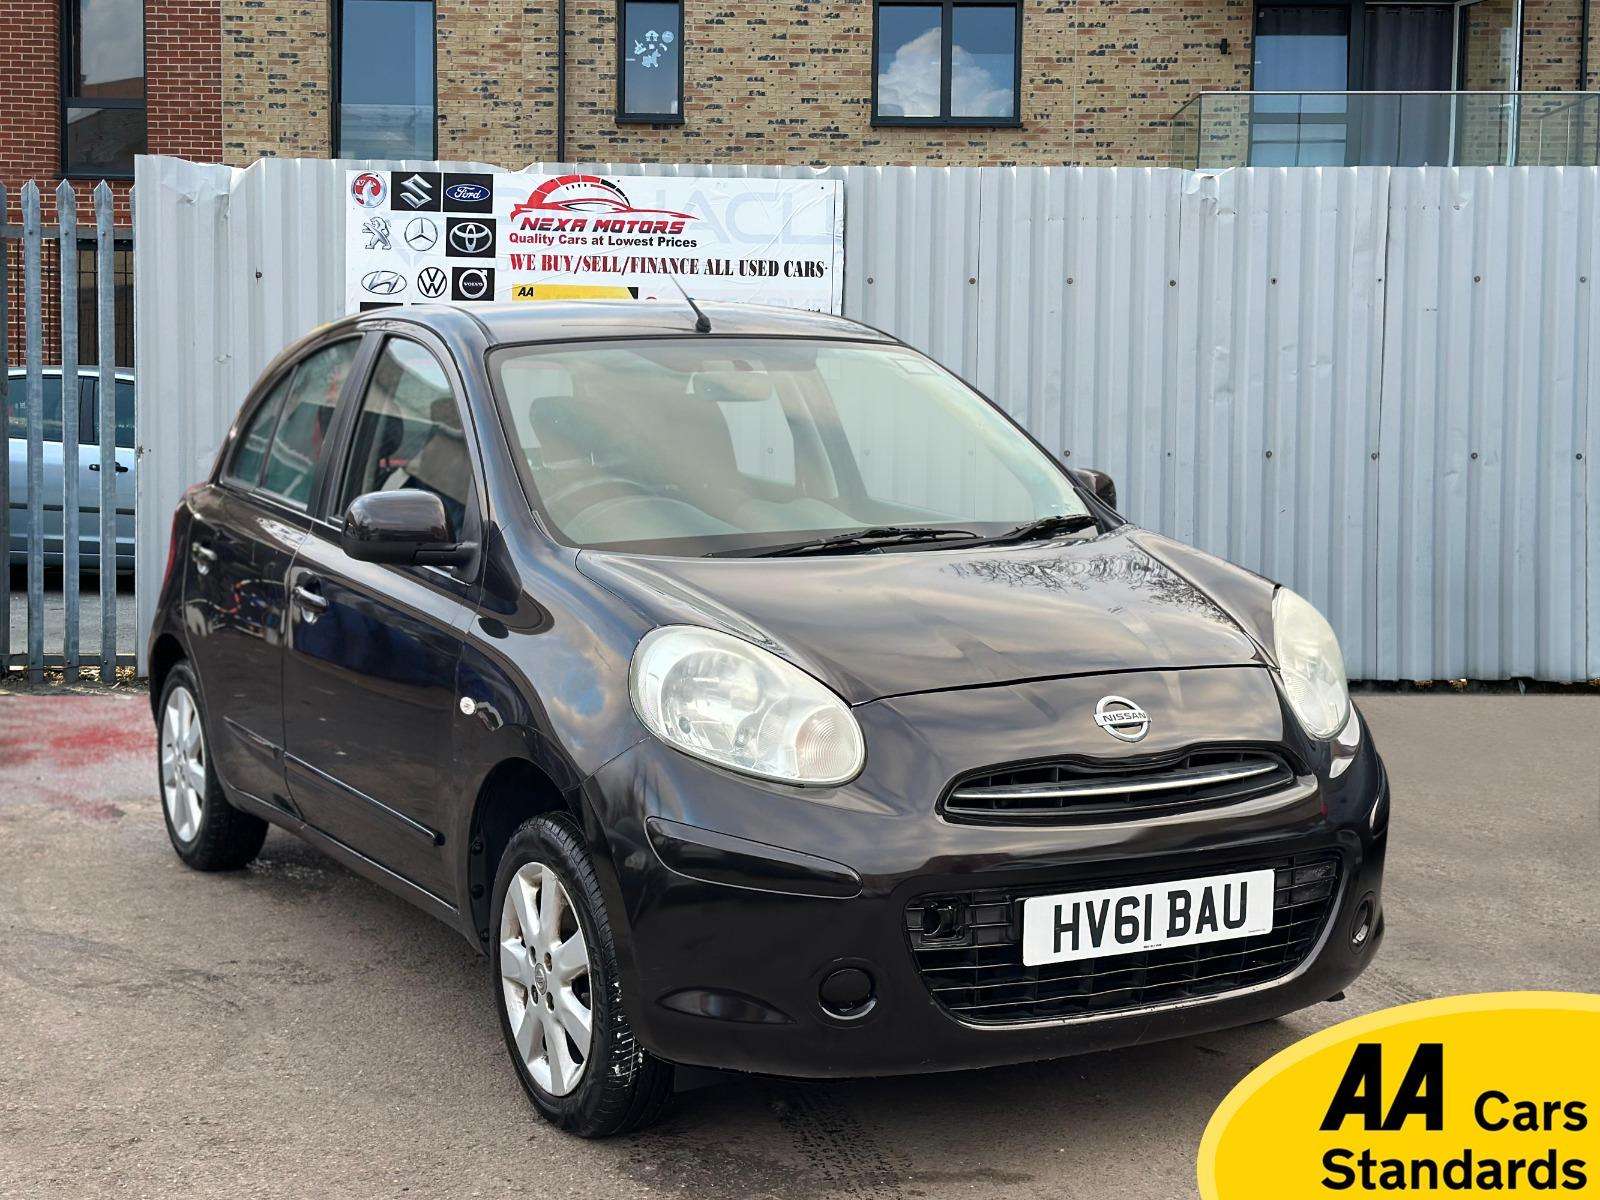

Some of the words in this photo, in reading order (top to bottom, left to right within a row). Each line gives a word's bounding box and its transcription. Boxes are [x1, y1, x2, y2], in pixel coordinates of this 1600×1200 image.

[454, 186, 482, 199] Ford
[520, 217, 588, 232] NEXA
[592, 219, 686, 235] MOTORS
[509, 233, 555, 246] Quality
[559, 234, 588, 245] Cars
[591, 236, 605, 246] at
[608, 236, 654, 247] Lowest
[658, 237, 698, 248] Prices
[509, 253, 536, 271] WE
[541, 254, 699, 276] BUY/SELL/FINANCE
[703, 258, 734, 276] ALL
[739, 259, 780, 277] USED
[783, 260, 825, 278] CARS
[517, 286, 535, 297] AA
[1102, 712, 1147, 722] NISSAN
[1053, 893, 1153, 954] HV61
[1166, 881, 1248, 938] BAU
